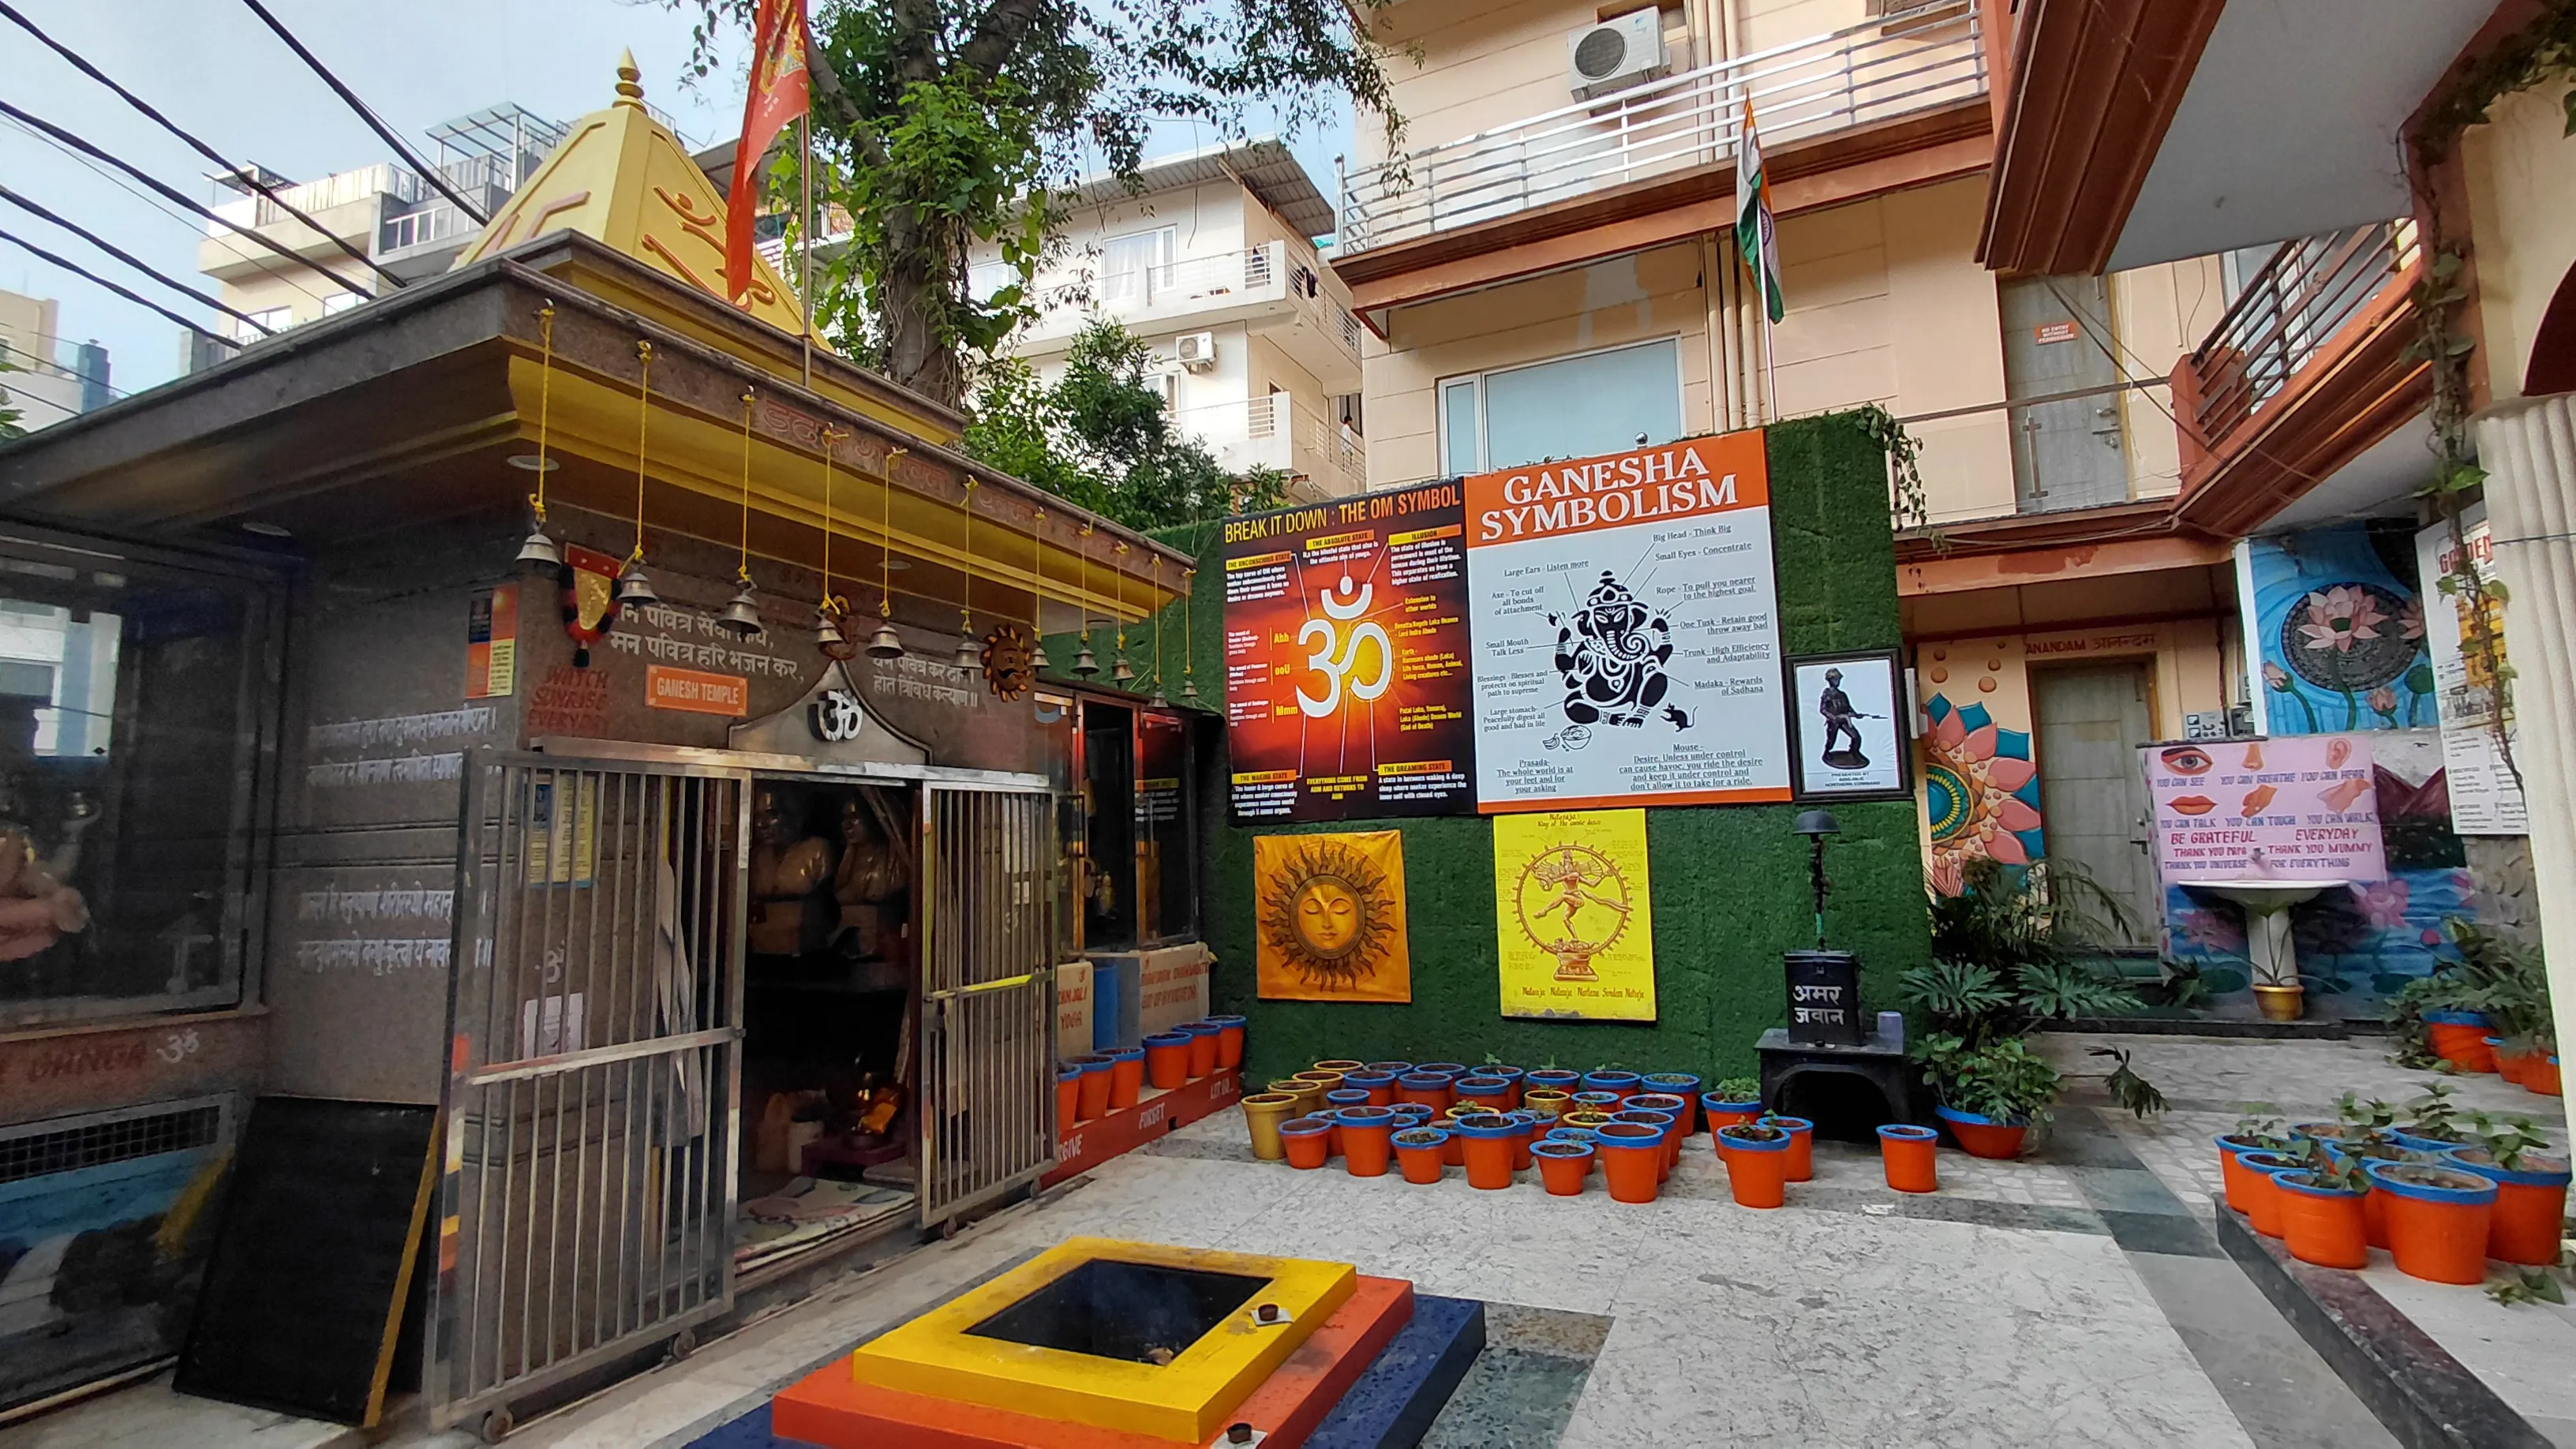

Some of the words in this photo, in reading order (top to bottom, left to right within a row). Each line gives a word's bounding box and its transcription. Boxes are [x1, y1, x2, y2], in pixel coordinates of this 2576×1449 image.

[1504, 447, 1709, 504] GANESHA
[1481, 474, 1739, 540] SYMBOLISM
[1225, 518, 1267, 543] BREAK
[1271, 515, 1282, 536] IT
[1286, 508, 1327, 533] DOWN
[1339, 501, 1366, 524] THE
[1370, 496, 1393, 519] OM
[1398, 485, 1460, 515] SYMBOL
[1412, 530, 1437, 540] ILLUSION
[1694, 526, 1716, 537] Think
[1718, 525, 1732, 534] Big
[1656, 552, 1676, 560] Small
[1679, 550, 1696, 559] Eyes
[1703, 542, 1752, 554] Concentrate
[1695, 581, 1710, 591] pull
[1708, 587, 1735, 597] highest
[1503, 604, 1542, 614] attachment
[644, 604, 695, 632] पवित्र
[1721, 616, 1746, 625] Retain
[1748, 612, 1767, 622] good
[1274, 632, 1289, 643] Ahh
[2025, 639, 2086, 654] ANANDAM
[611, 631, 642, 655] मन
[645, 633, 695, 661] पवित्र
[697, 642, 726, 668] हरि
[730, 650, 769, 676] भजन
[1723, 652, 1770, 662] Adaptability
[545, 665, 608, 688] WATCH
[1730, 676, 1763, 686] Rewards
[874, 672, 896, 695] होत
[657, 677, 698, 699] GANESH
[701, 683, 739, 704] TEMPLE
[1276, 706, 1297, 716] Mmm
[1717, 749, 1745, 758] control
[1738, 758, 1762, 766] desire
[1649, 772, 1667, 781] keep
[1703, 769, 1732, 777] control
[2190, 777, 2205, 786] SEE
[2193, 818, 2216, 827] TALK
[2226, 818, 2242, 827] YOU
[2246, 817, 2264, 826] CAN
[2267, 816, 2295, 826] TOUCH
[2171, 833, 2185, 844] BE
[2191, 830, 2256, 844] GRATEFUL
[2296, 828, 2358, 841] EVERYDAY
[2174, 848, 2206, 857] THANK
[2208, 848, 2224, 856] YOU
[2227, 847, 2246, 856] PAPA
[2268, 845, 2301, 854] THANK
[2306, 844, 2323, 853] YOU
[2328, 843, 2372, 852] MUMMY
[2290, 858, 2349, 868] EVERYTHING
[1792, 985, 1843, 1005] अमर
[1060, 1011, 1082, 1029] YOGA
[1794, 1007, 1844, 1025] जवान
